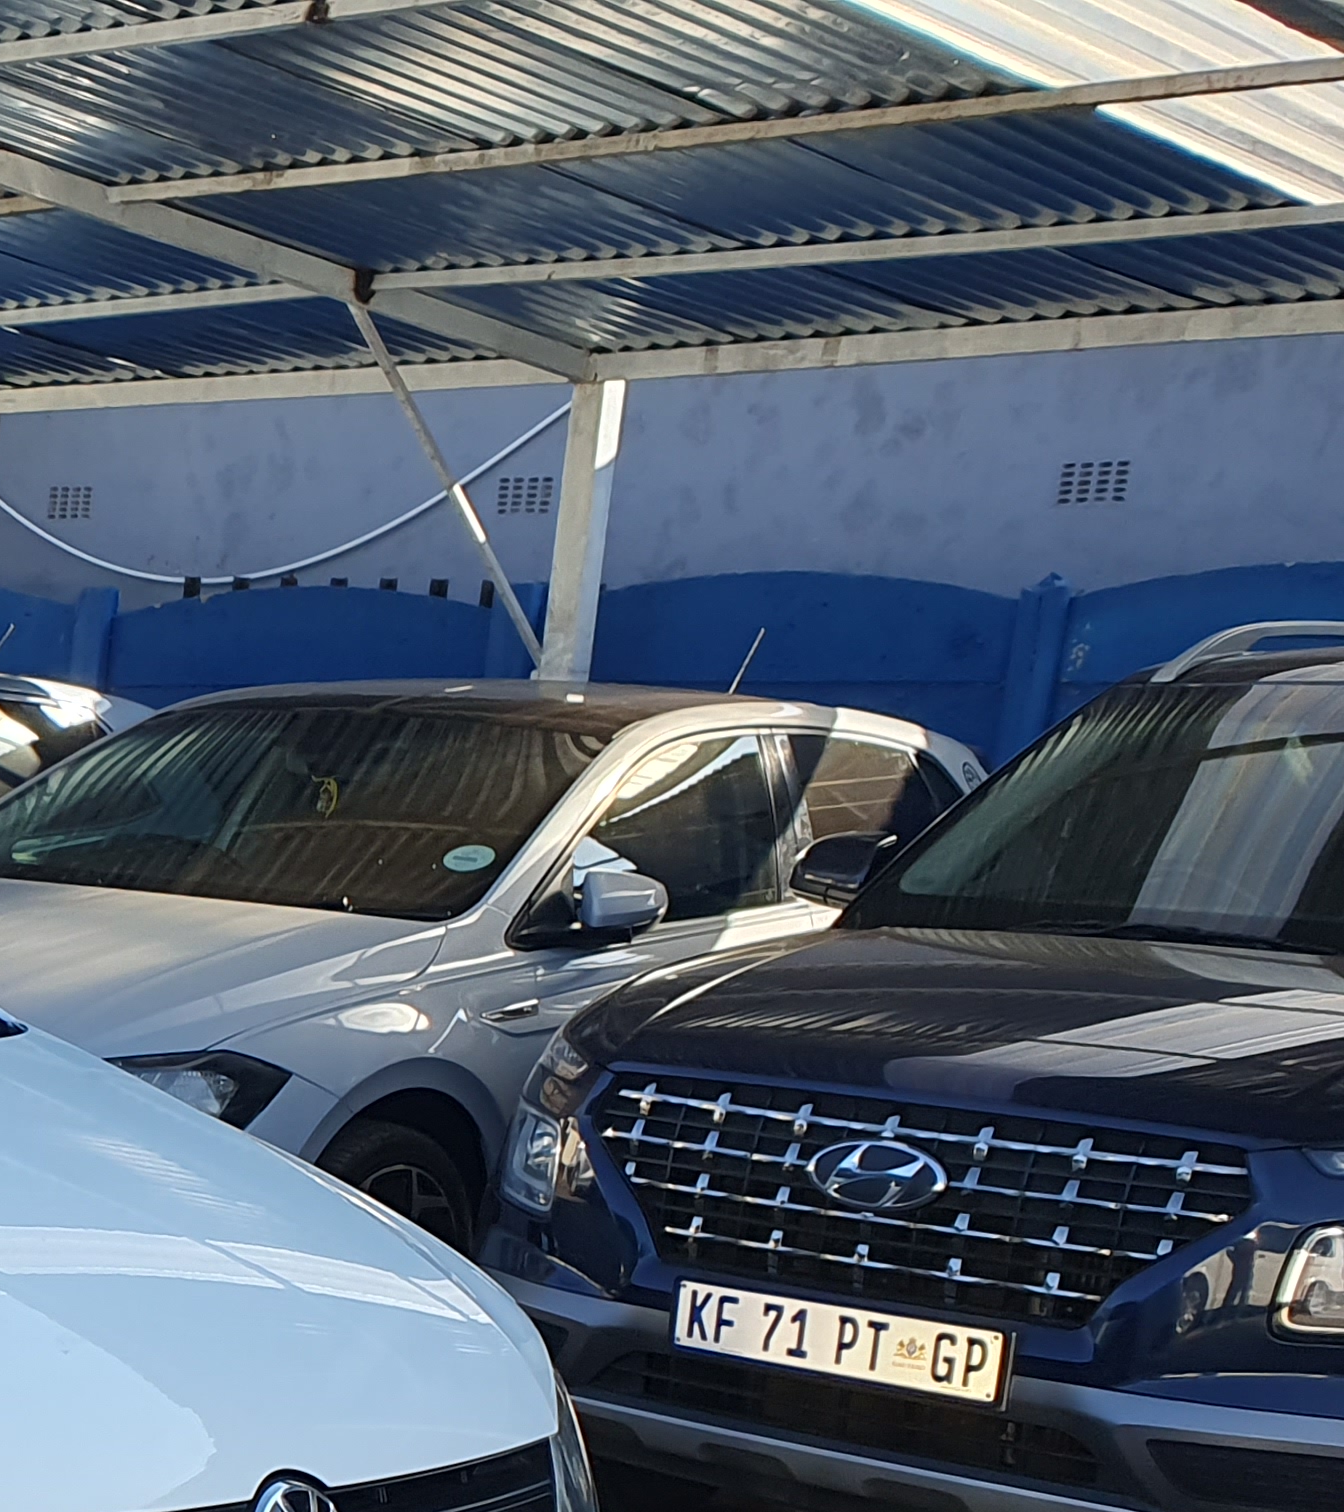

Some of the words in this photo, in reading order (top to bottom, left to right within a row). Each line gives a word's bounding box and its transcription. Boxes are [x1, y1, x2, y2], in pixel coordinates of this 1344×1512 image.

[686, 1290, 740, 1344] KF
[761, 1303, 809, 1359] 71
[834, 1315, 890, 1371] PT
[929, 1332, 989, 1387] GP
